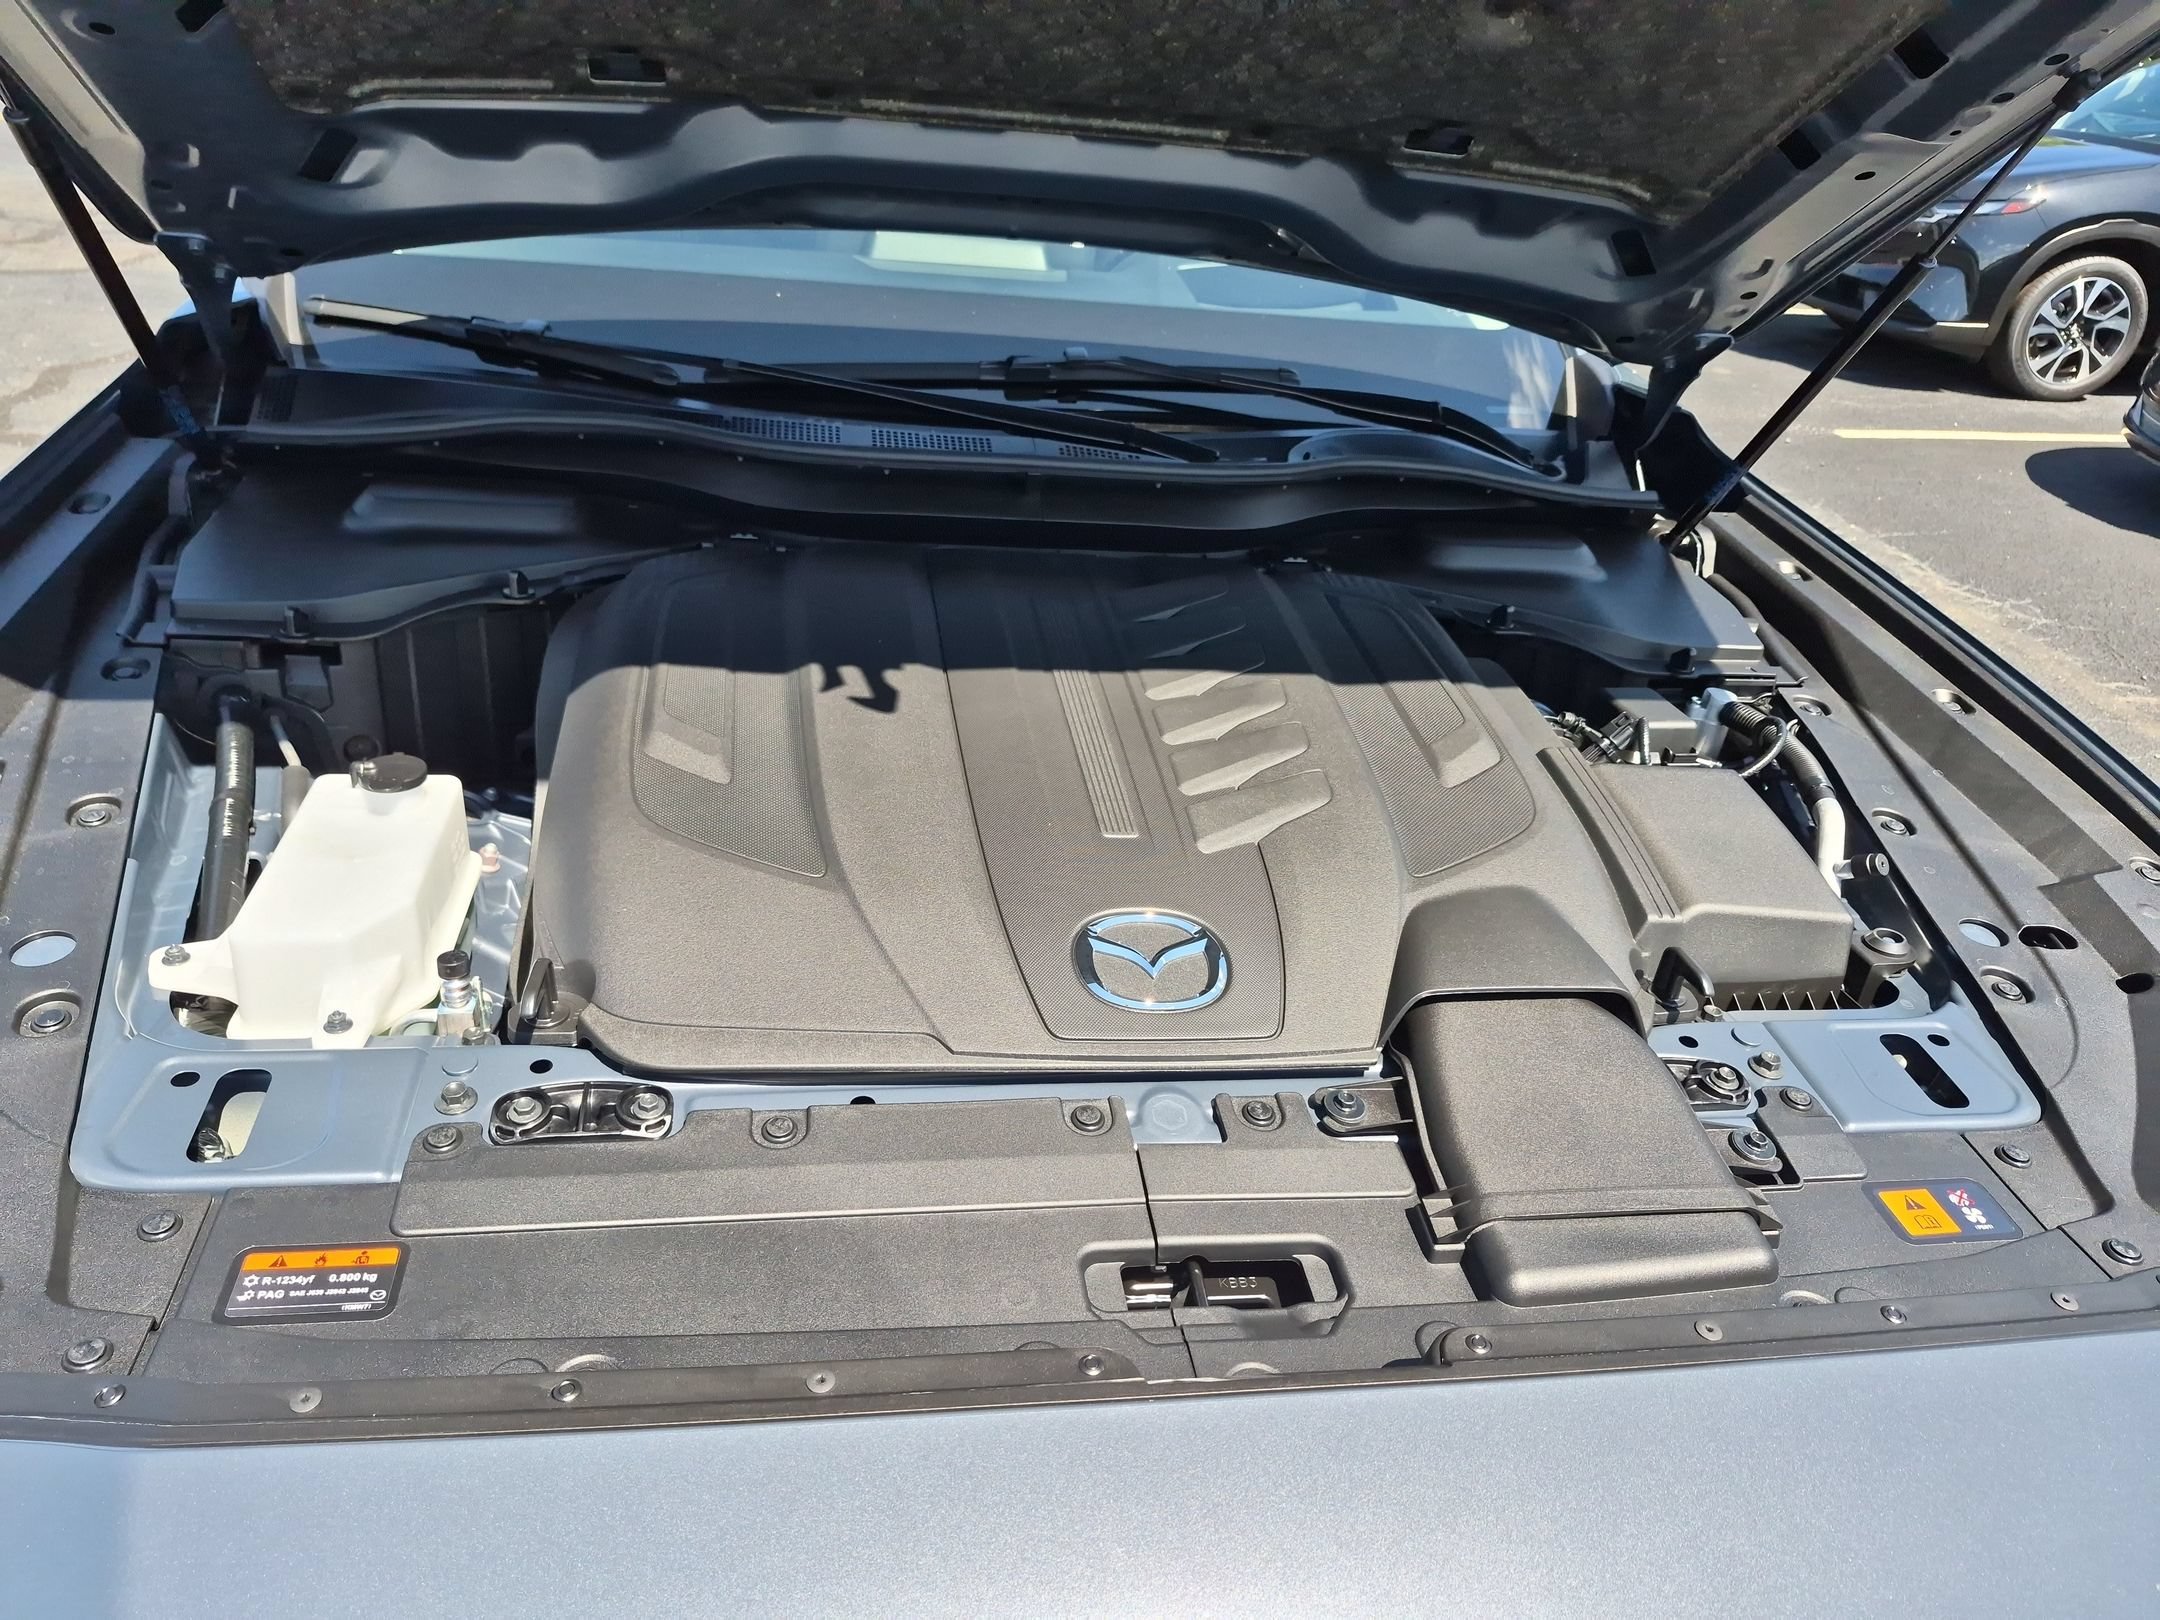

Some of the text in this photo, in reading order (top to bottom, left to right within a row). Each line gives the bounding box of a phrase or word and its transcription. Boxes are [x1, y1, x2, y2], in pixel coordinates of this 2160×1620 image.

[261, 1271, 378, 1286] R-1234yf 0.800 kg
[256, 1289, 285, 1300] PAG
